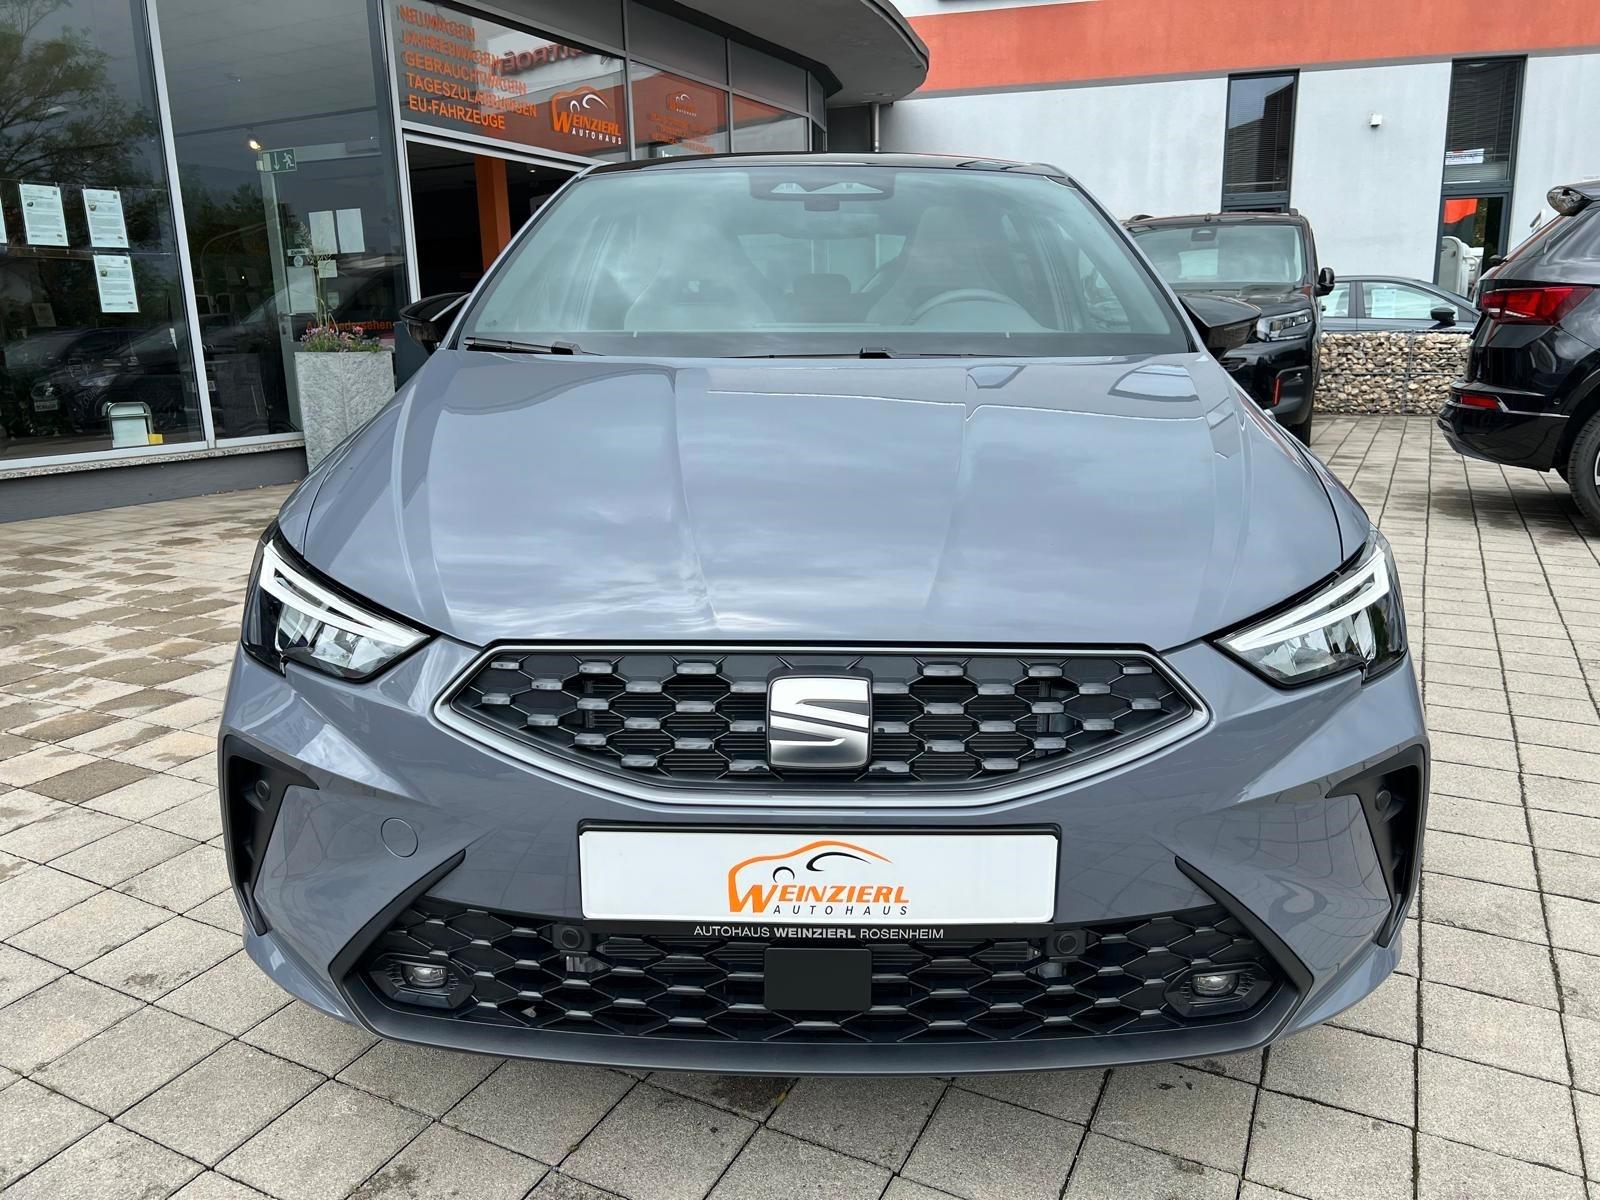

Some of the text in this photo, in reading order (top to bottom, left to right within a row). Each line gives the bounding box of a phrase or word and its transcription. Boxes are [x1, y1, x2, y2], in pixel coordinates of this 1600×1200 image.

[398, 4, 475, 41] NEUWAGEN
[402, 30, 500, 70] JAHRESWAGEN
[404, 50, 528, 95] GEBRAUCHTWAGEN
[406, 72, 537, 118] TAGESZULASSUNGEN
[408, 94, 506, 130] EU-FAHRZEUGE
[552, 111, 621, 137] WEINZIERL
[571, 127, 622, 145] AUTOHAUS
[729, 884, 910, 914] WEINZIERL
[773, 905, 908, 916] AUTOHAUS
[693, 925, 945, 940] AUTOHAUS WEINZIERL ROSENHEIM
